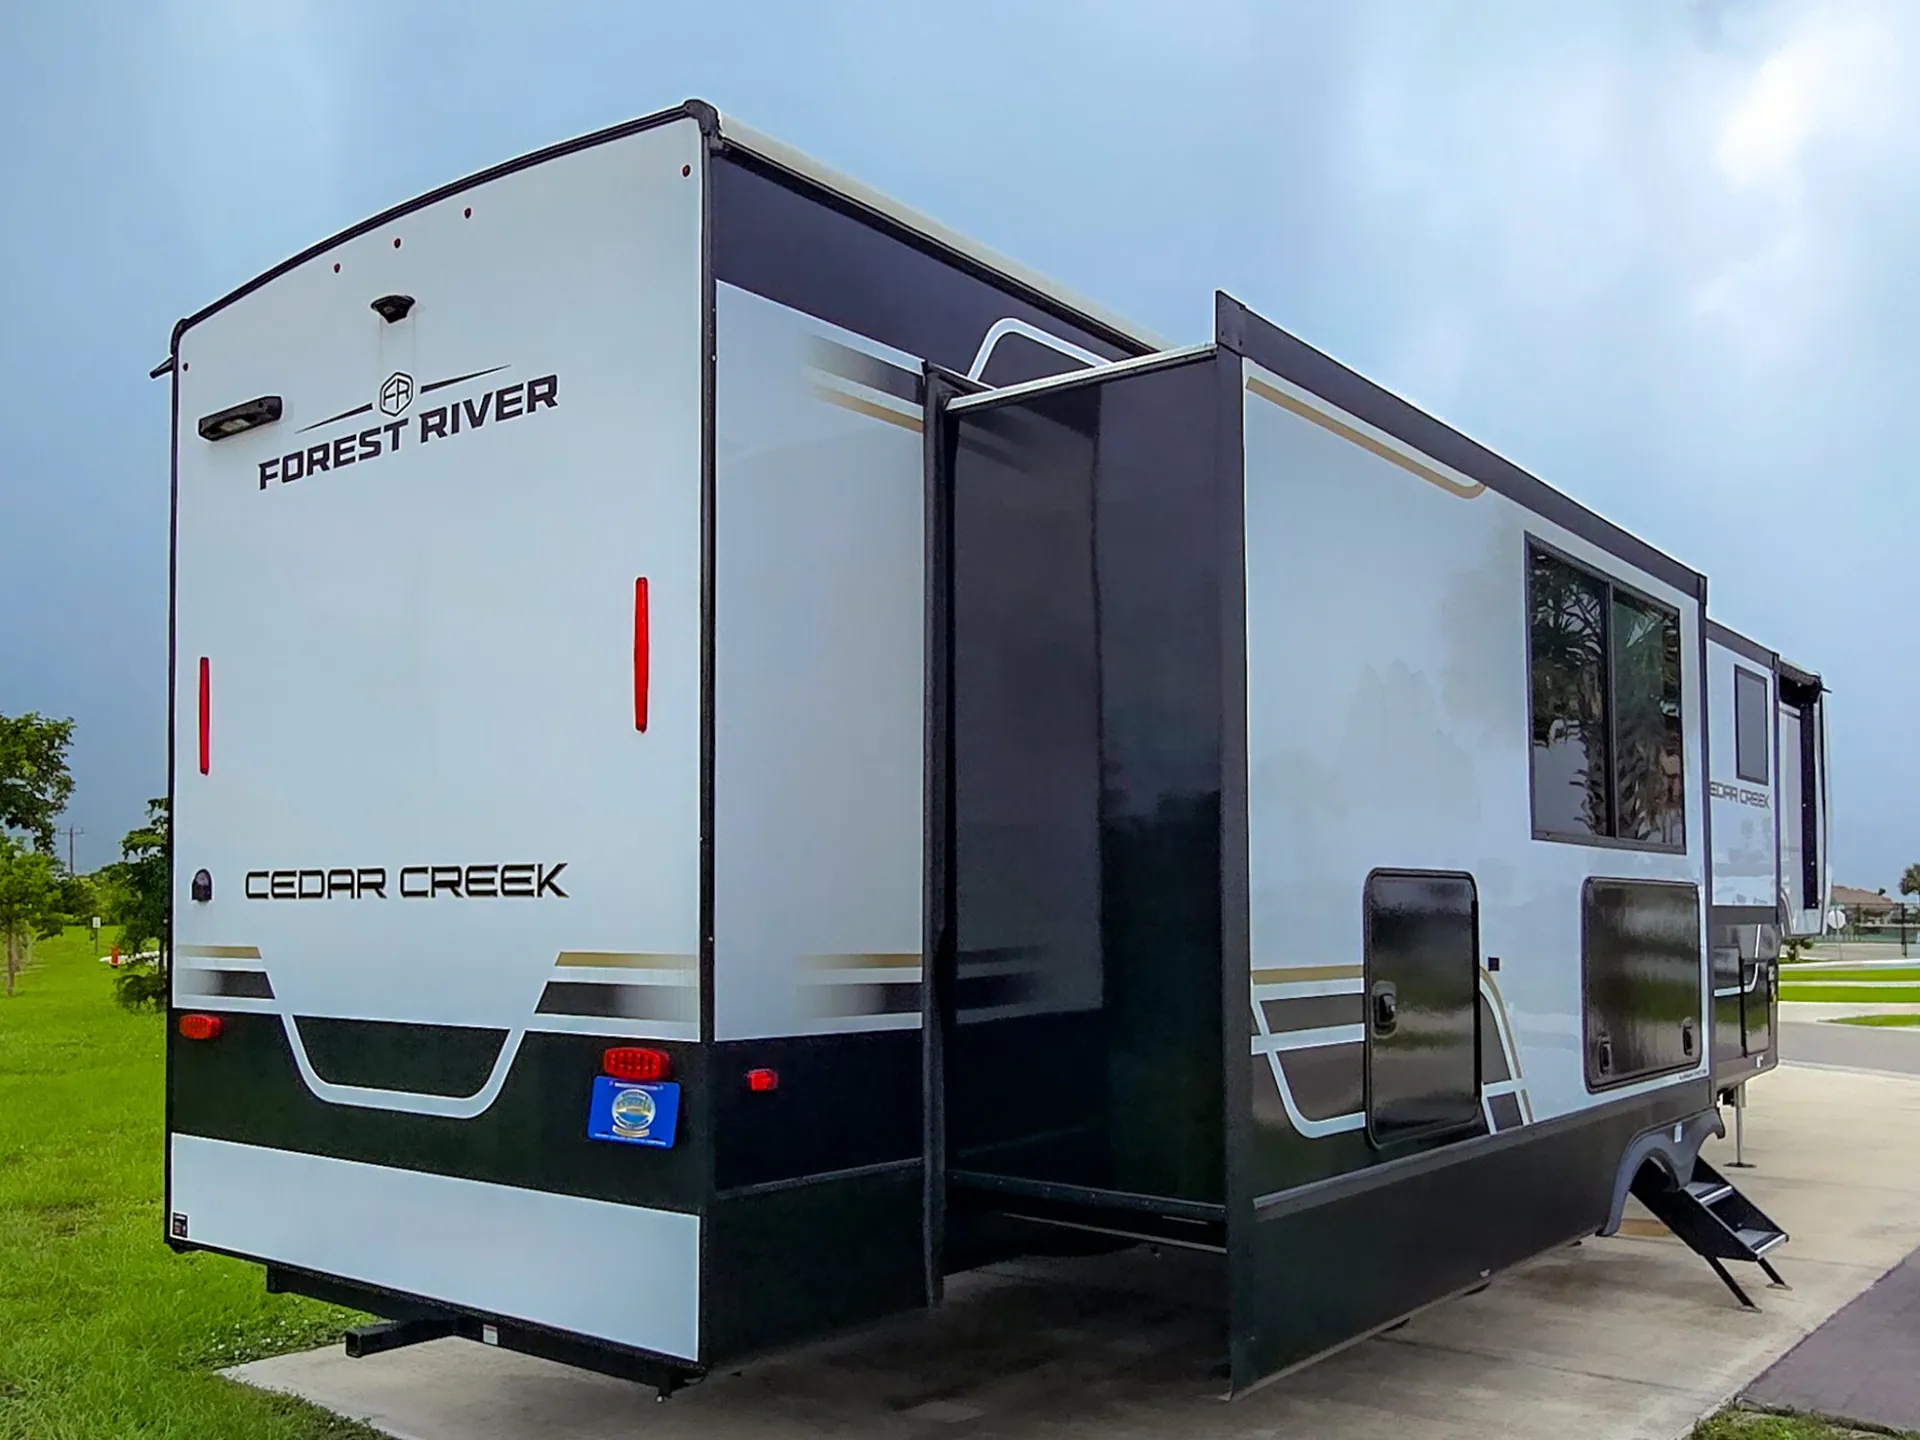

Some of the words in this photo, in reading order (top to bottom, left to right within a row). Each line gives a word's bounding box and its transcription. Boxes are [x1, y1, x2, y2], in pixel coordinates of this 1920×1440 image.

[257, 417, 410, 491] FOREST
[418, 373, 559, 444] RIVER
[1709, 781, 1738, 803] EDAR
[1740, 788, 1771, 811] CREEK
[245, 867, 388, 900] CEDAR
[399, 862, 570, 898] CREEK
